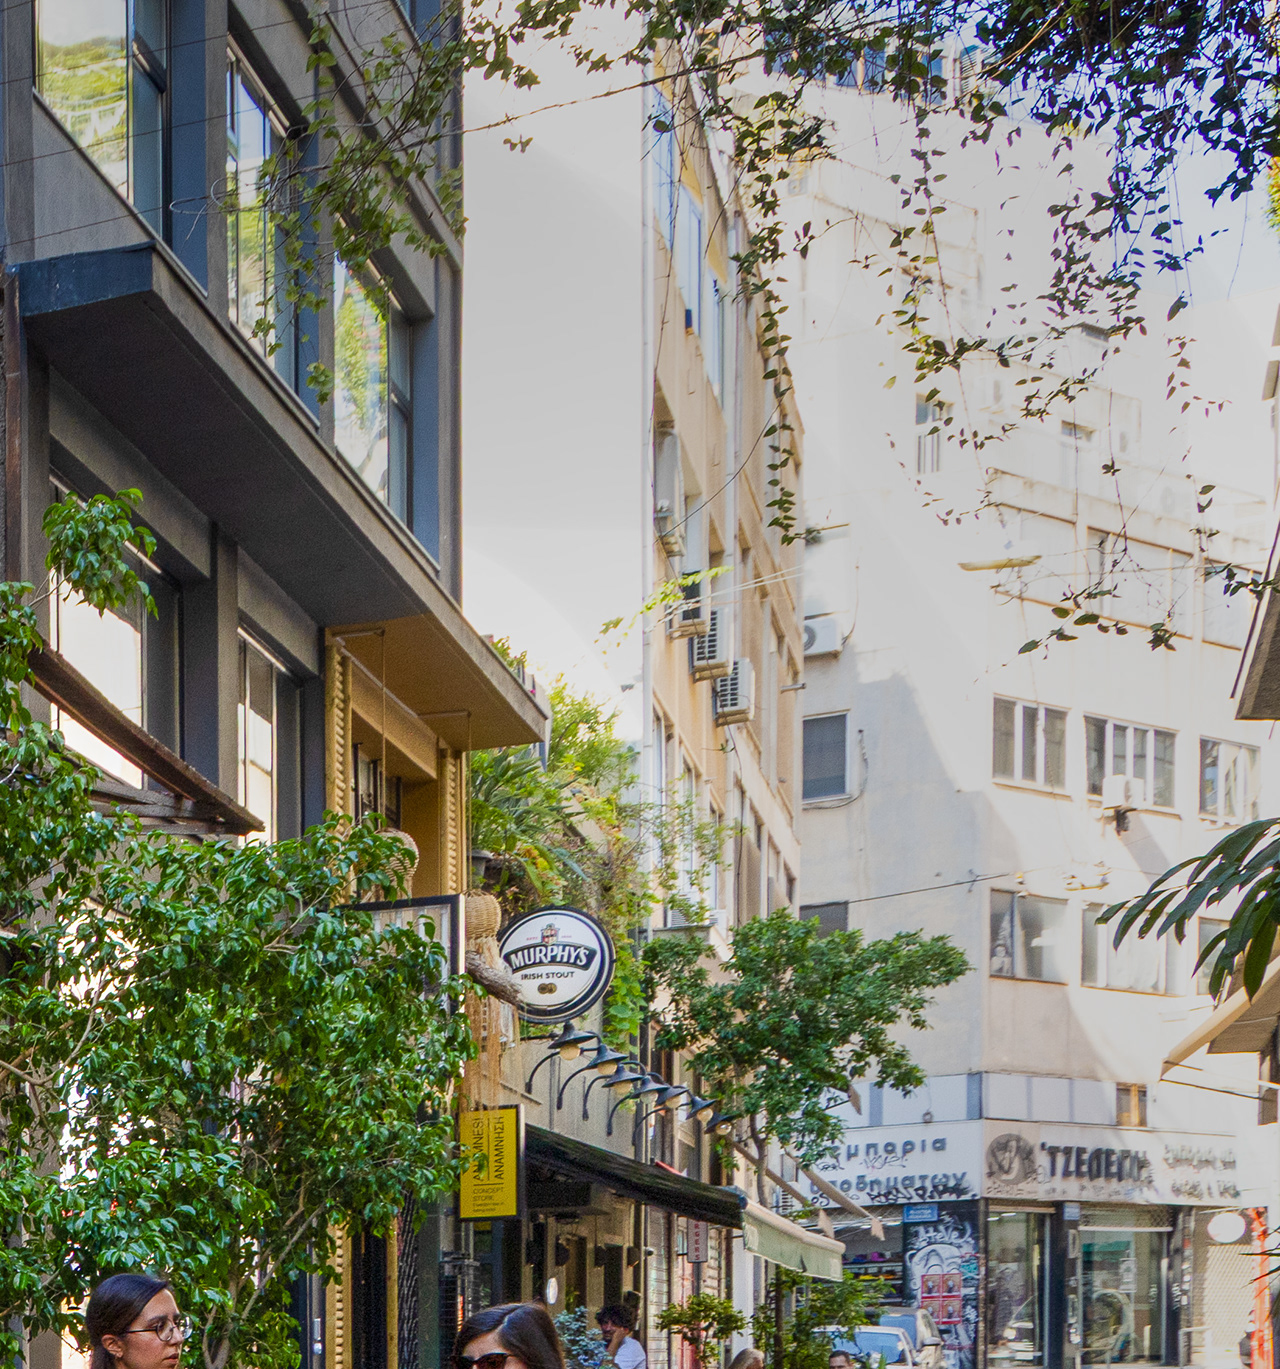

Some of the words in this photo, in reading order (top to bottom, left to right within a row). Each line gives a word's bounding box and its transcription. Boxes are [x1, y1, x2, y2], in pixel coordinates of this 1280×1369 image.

[509, 944, 590, 971] MURPHY'S
[521, 973, 544, 981] IRISH
[545, 971, 576, 980] STOUT
